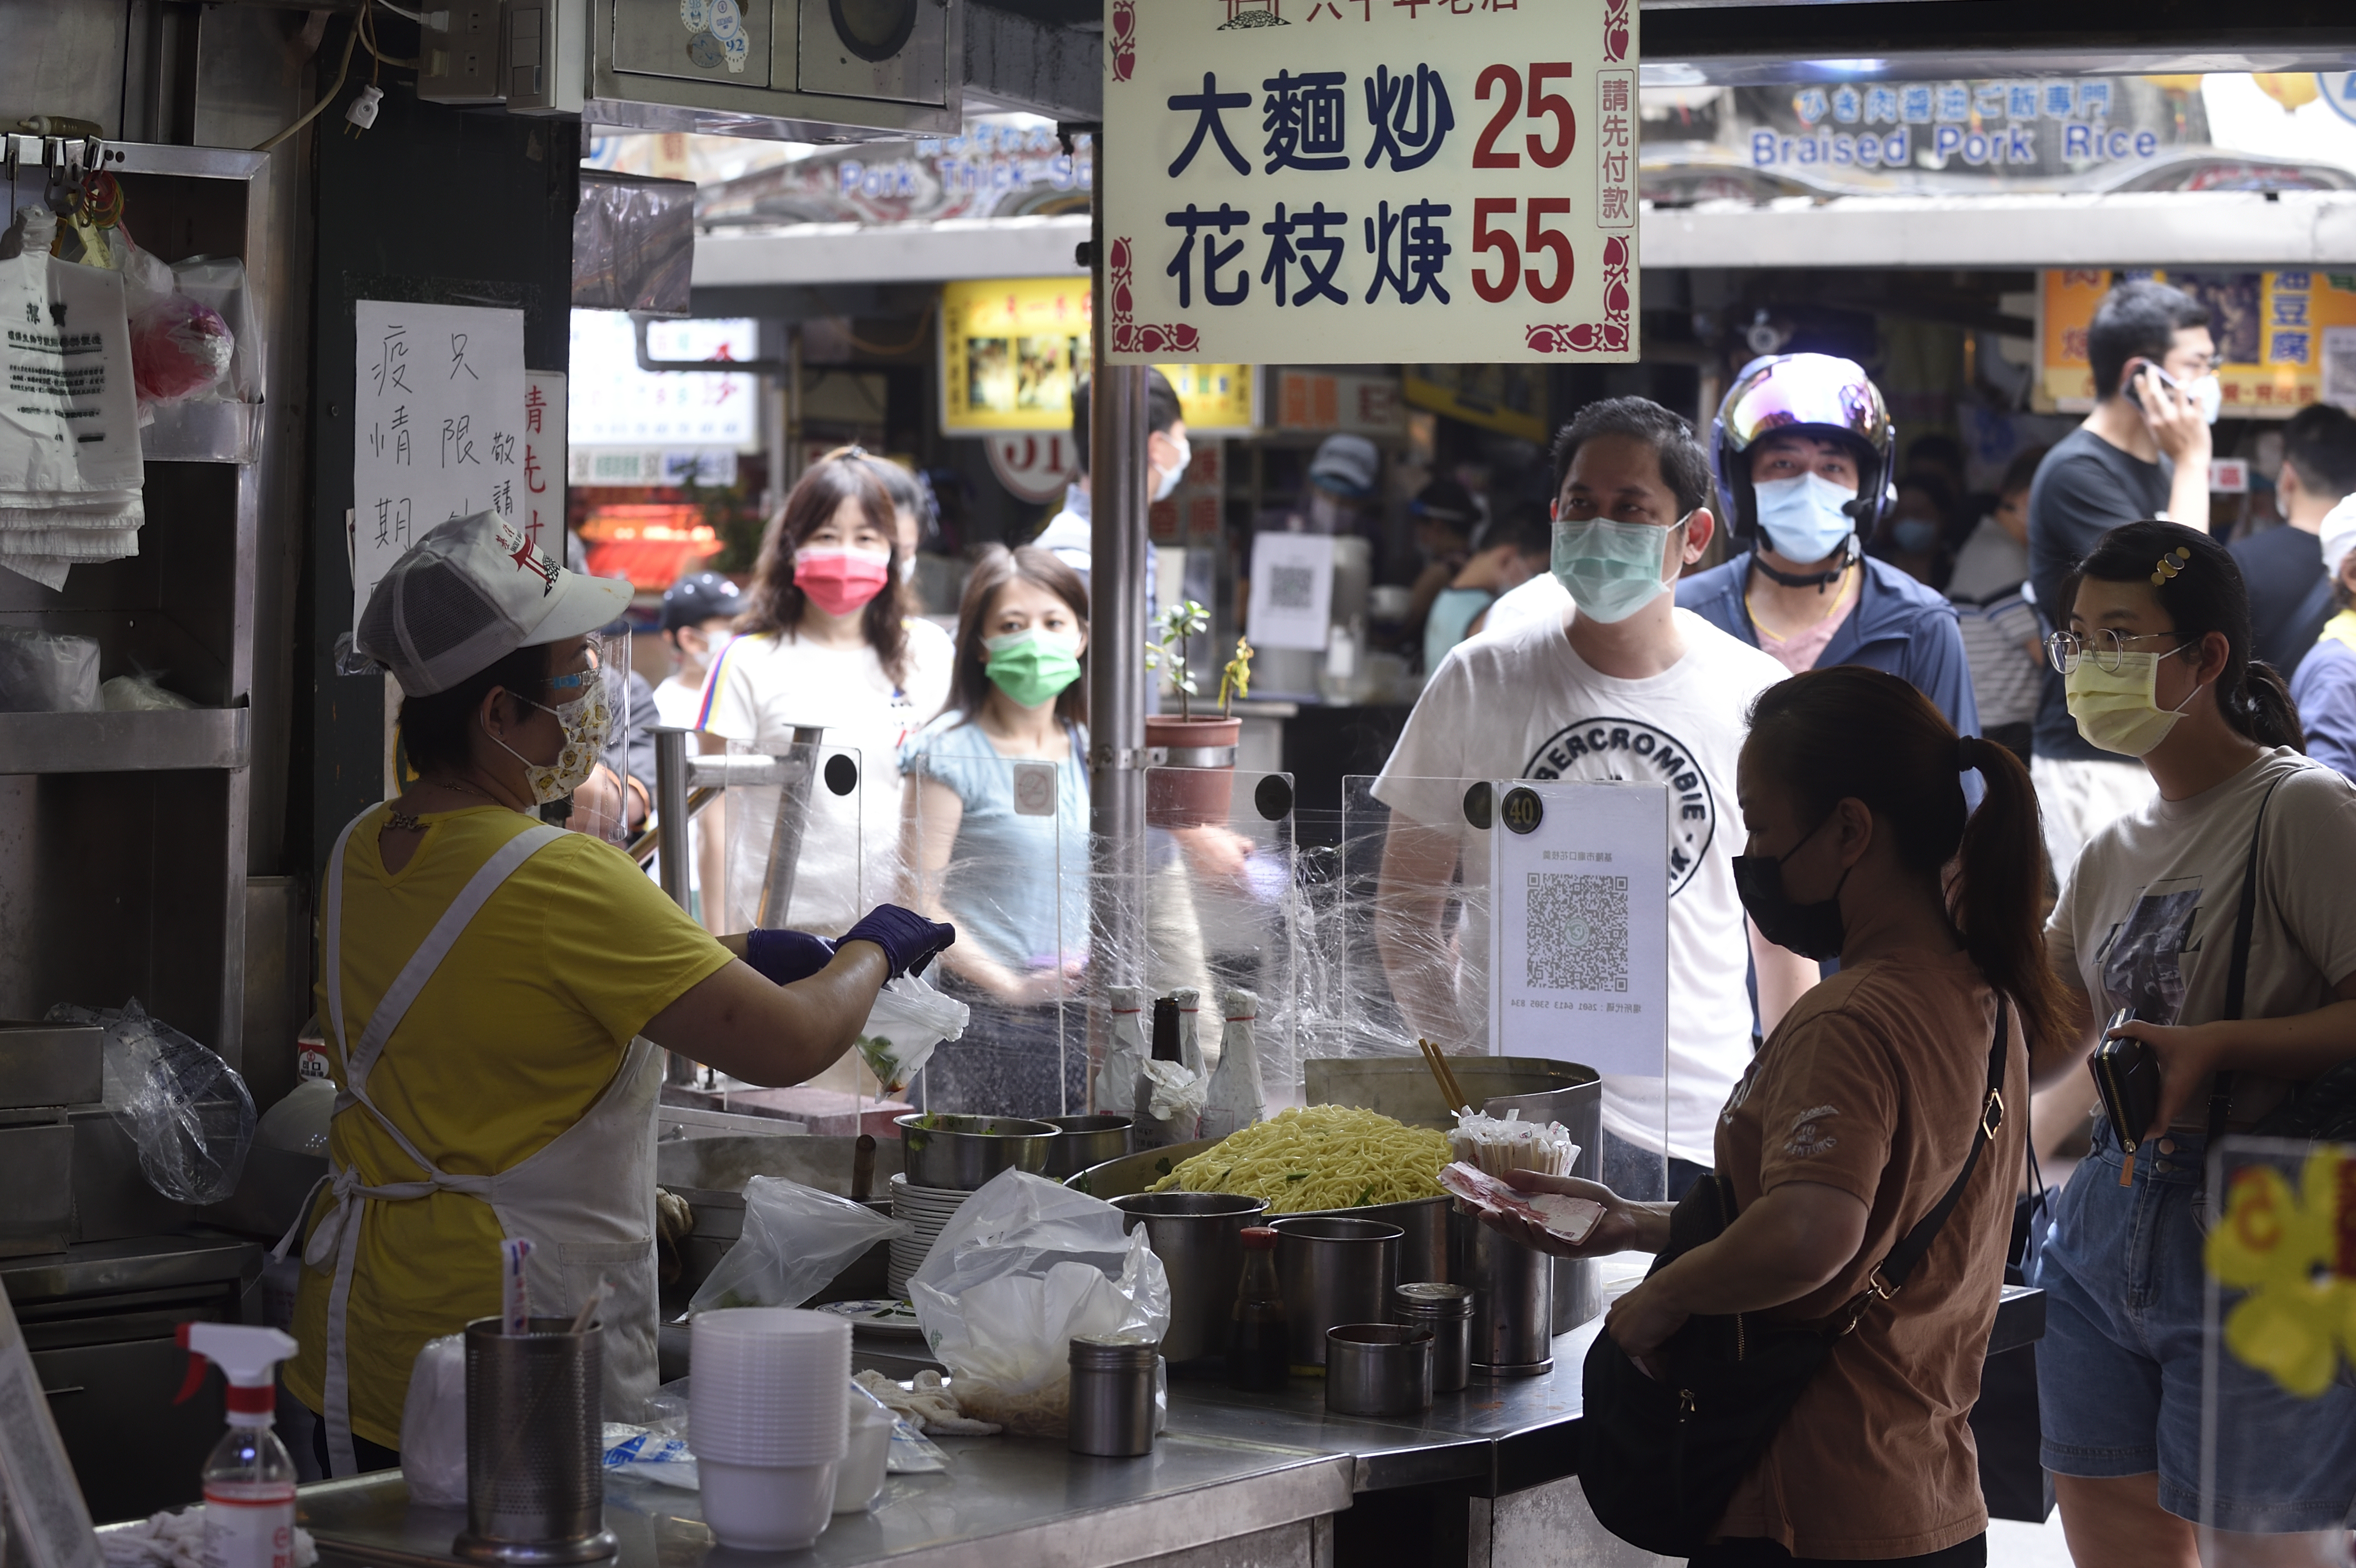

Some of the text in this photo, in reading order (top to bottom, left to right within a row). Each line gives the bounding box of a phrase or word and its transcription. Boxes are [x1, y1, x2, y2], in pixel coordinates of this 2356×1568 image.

[726, 39, 743, 51] 92
[1167, 62, 1576, 178] 大麵炒 25
[1602, 78, 1629, 219] 請先付款
[1752, 123, 2157, 165] Braised Pork Rice
[841, 161, 914, 194] Pork
[941, 159, 1028, 190] Thick
[1166, 198, 1575, 308] 花枝焿 55
[1533, 727, 1707, 821] BERCROMBIE
[1509, 797, 1534, 824] 40
